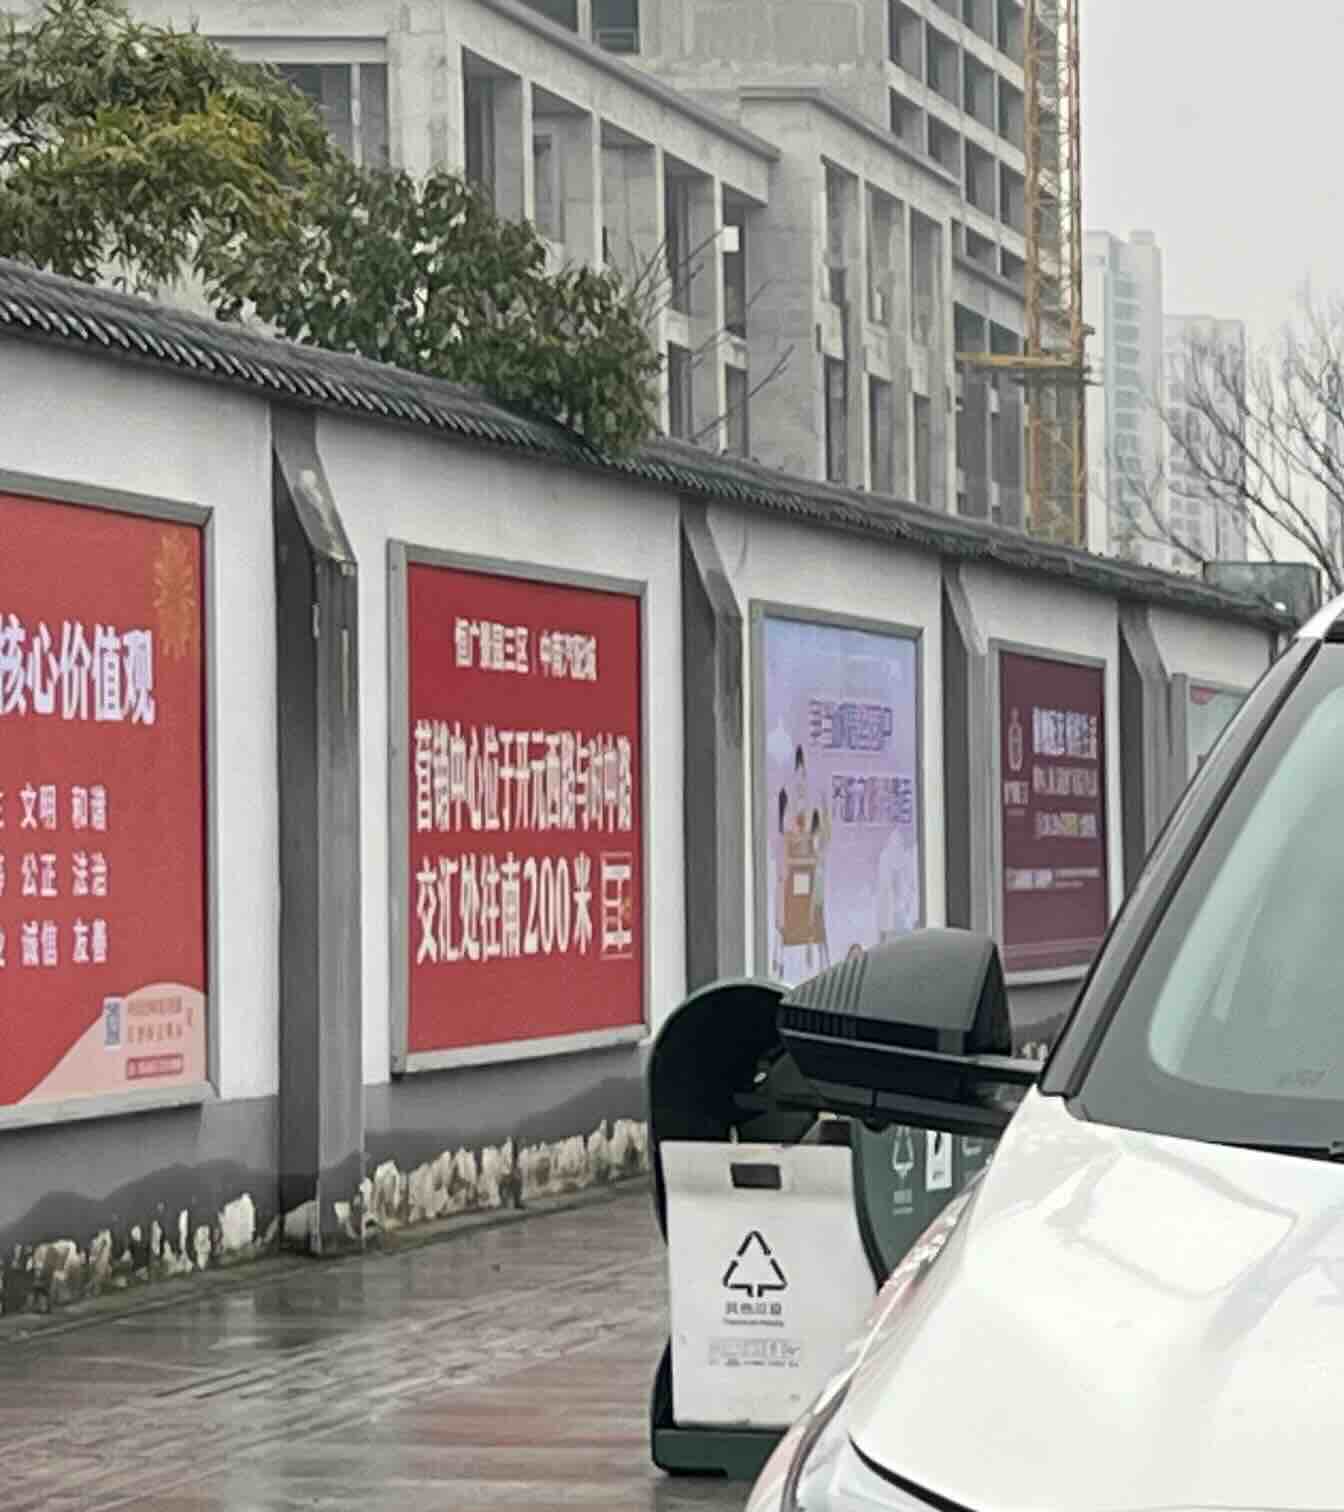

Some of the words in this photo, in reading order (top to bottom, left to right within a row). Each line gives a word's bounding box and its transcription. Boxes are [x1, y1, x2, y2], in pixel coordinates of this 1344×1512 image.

[0, 613, 156, 725] 核心价值观
[20, 782, 57, 830] 文明
[71, 783, 106, 832] 和谐
[21, 852, 58, 896] 公正
[71, 851, 107, 896] 法治
[416, 852, 593, 964] 交汇处往南200米
[22, 920, 57, 967] 诚信
[72, 917, 107, 963] 友善
